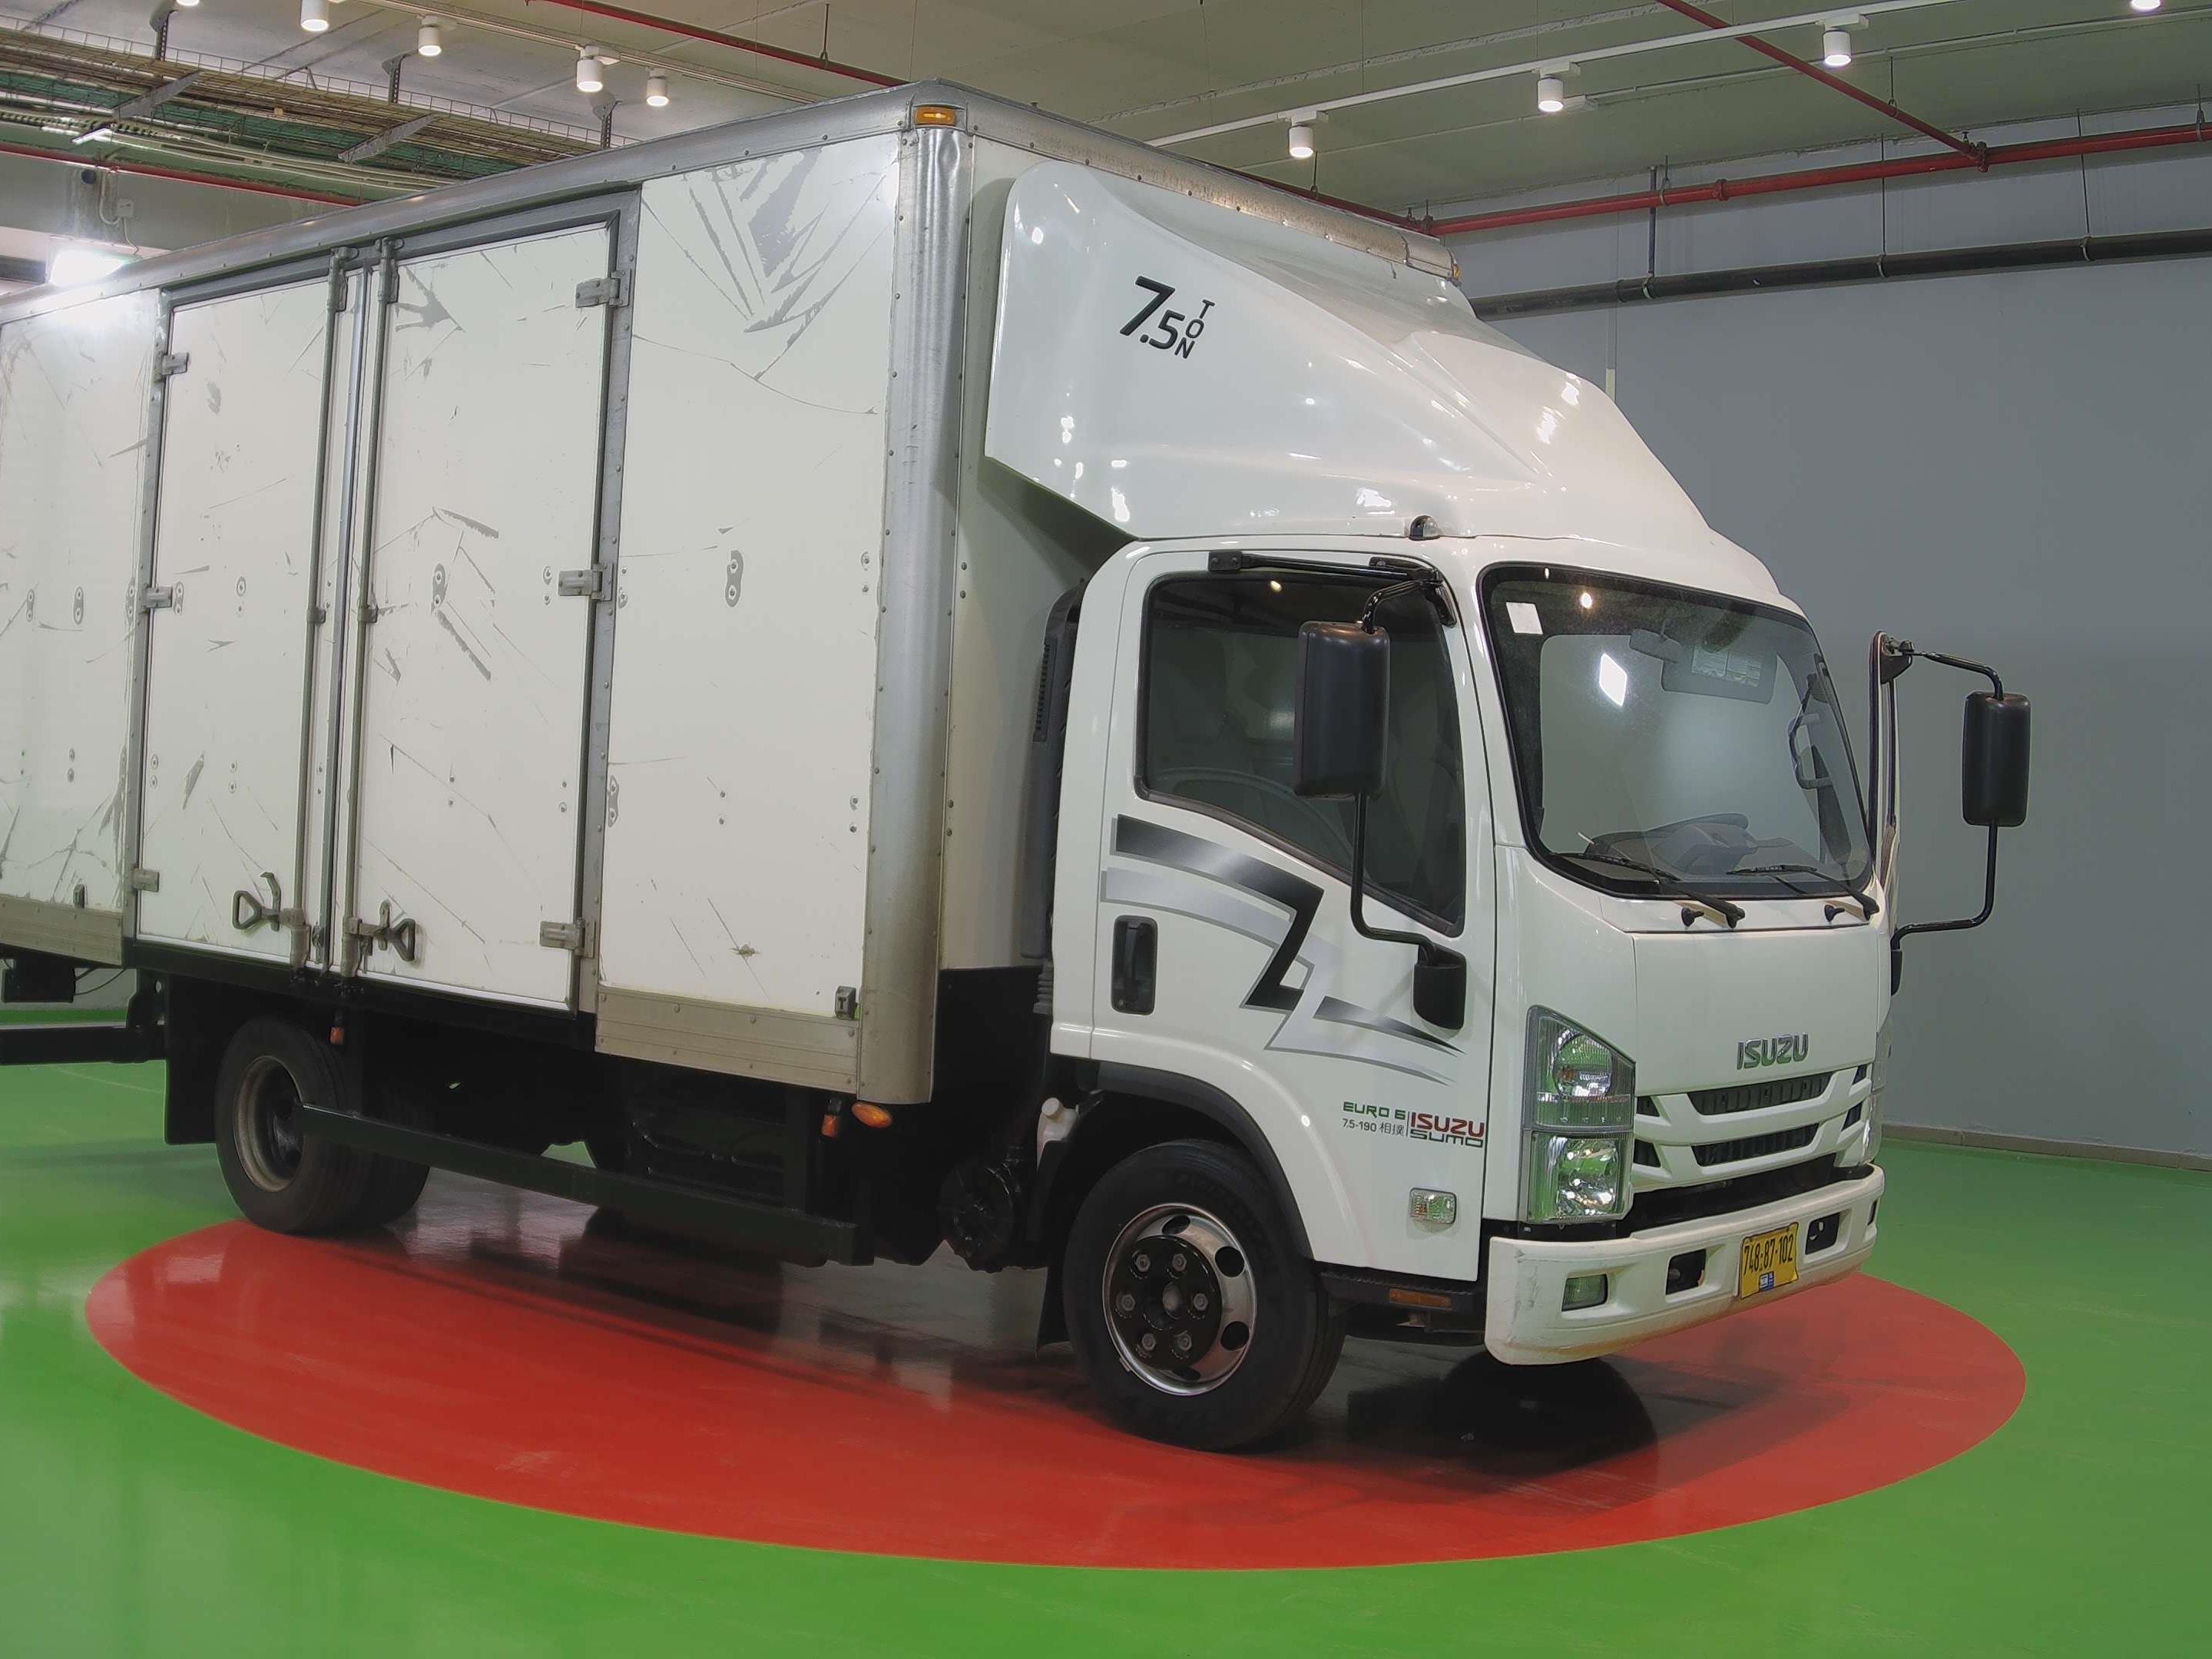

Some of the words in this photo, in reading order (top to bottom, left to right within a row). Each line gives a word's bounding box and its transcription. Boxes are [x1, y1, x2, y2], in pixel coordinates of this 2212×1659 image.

[1120, 276, 1185, 349] 7.5
[1174, 299, 1215, 359] TON
[1737, 1033, 1808, 1070] ISUZU
[1343, 1101, 1389, 1118] EURO
[1395, 1109, 1406, 1120] 6
[1410, 1112, 1485, 1137] ISUZU
[1409, 1129, 1483, 1148] SUMO
